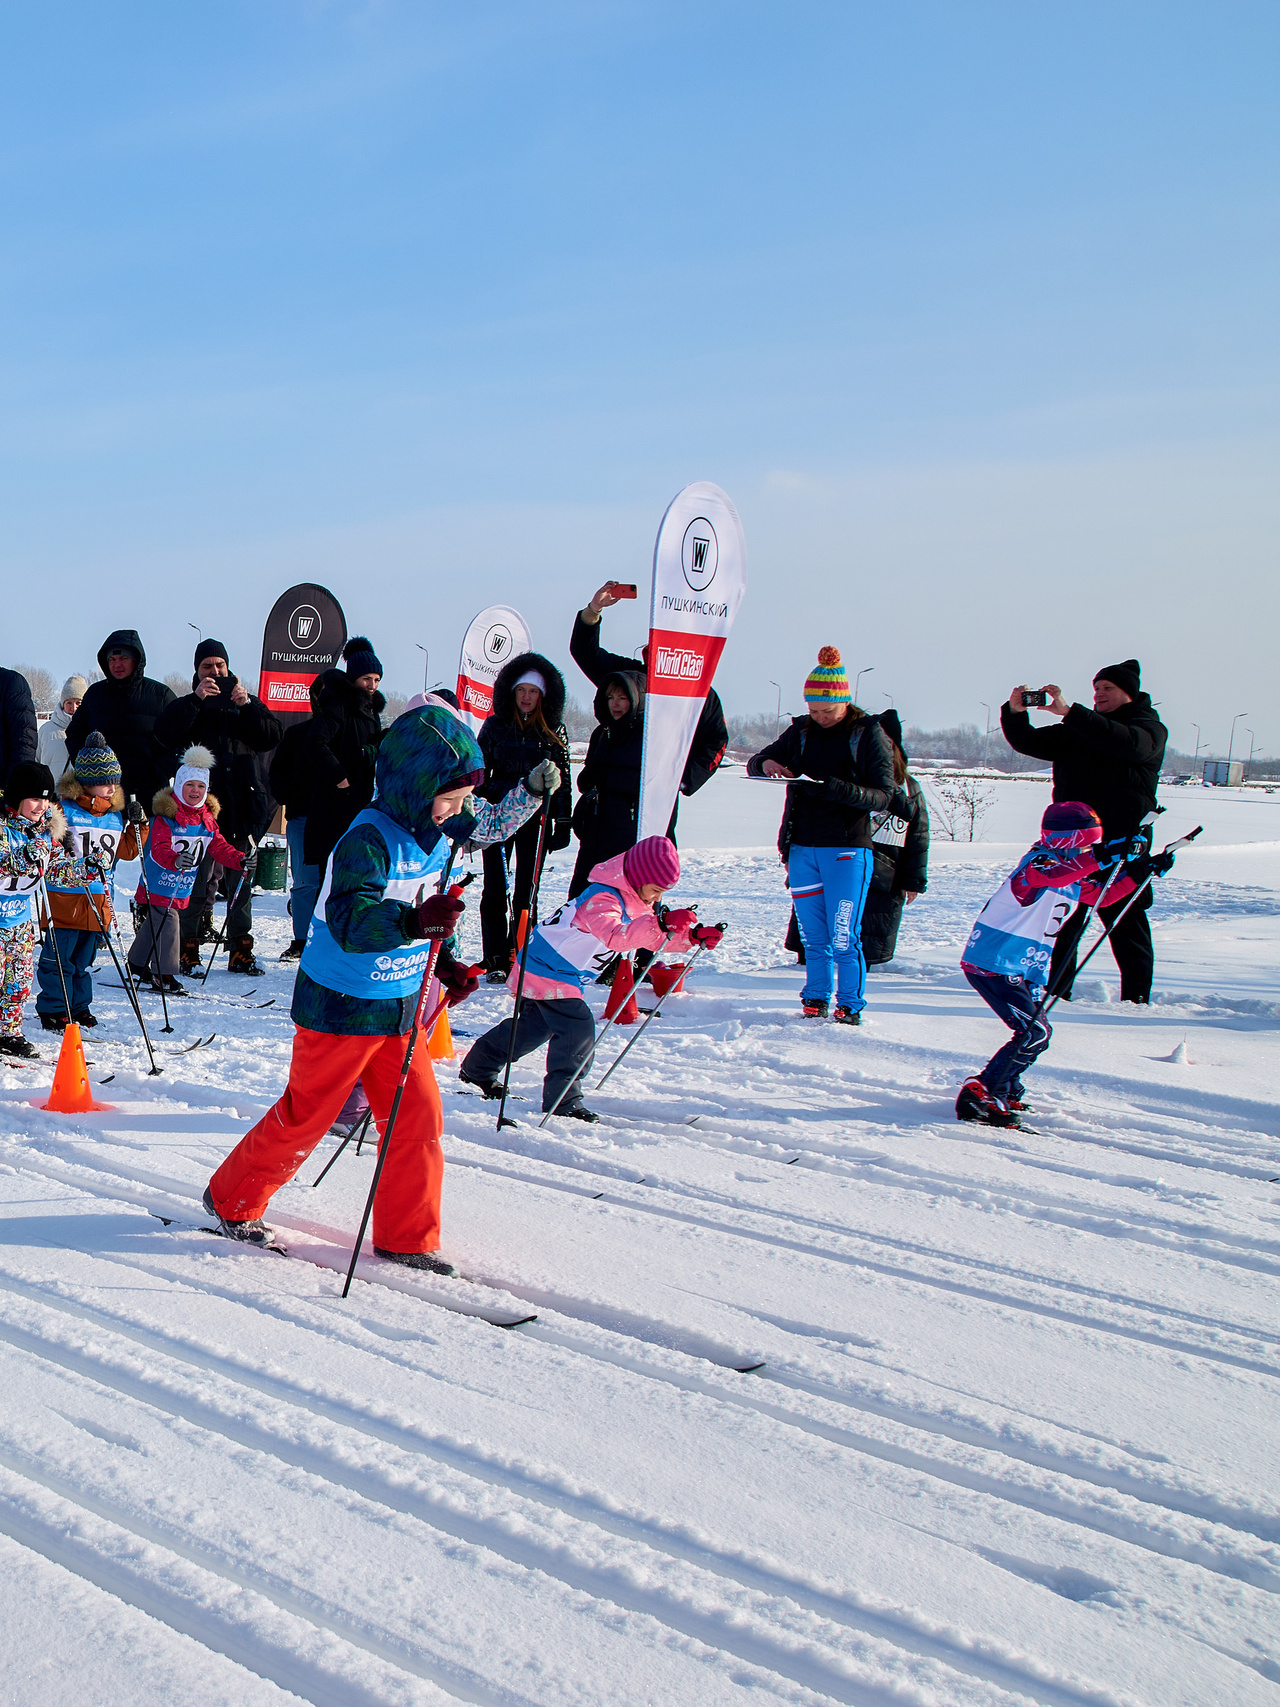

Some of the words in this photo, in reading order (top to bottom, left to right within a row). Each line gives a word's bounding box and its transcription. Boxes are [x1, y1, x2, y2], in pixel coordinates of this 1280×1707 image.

[661, 595, 728, 618] ПУШКИНСКИЙ
[271, 651, 332, 663] ПУШКИНСКИЙ
[656, 650, 681, 675] World
[270, 684, 293, 699] World
[293, 685, 310, 700] Clas
[78, 831, 116, 865] 18
[158, 879, 188, 889] OUTDOR
[839, 901, 852, 926] Class
[834, 924, 850, 950] World
[370, 965, 417, 981] OUTDOOR
[420, 952, 438, 1011] MADSHUS
